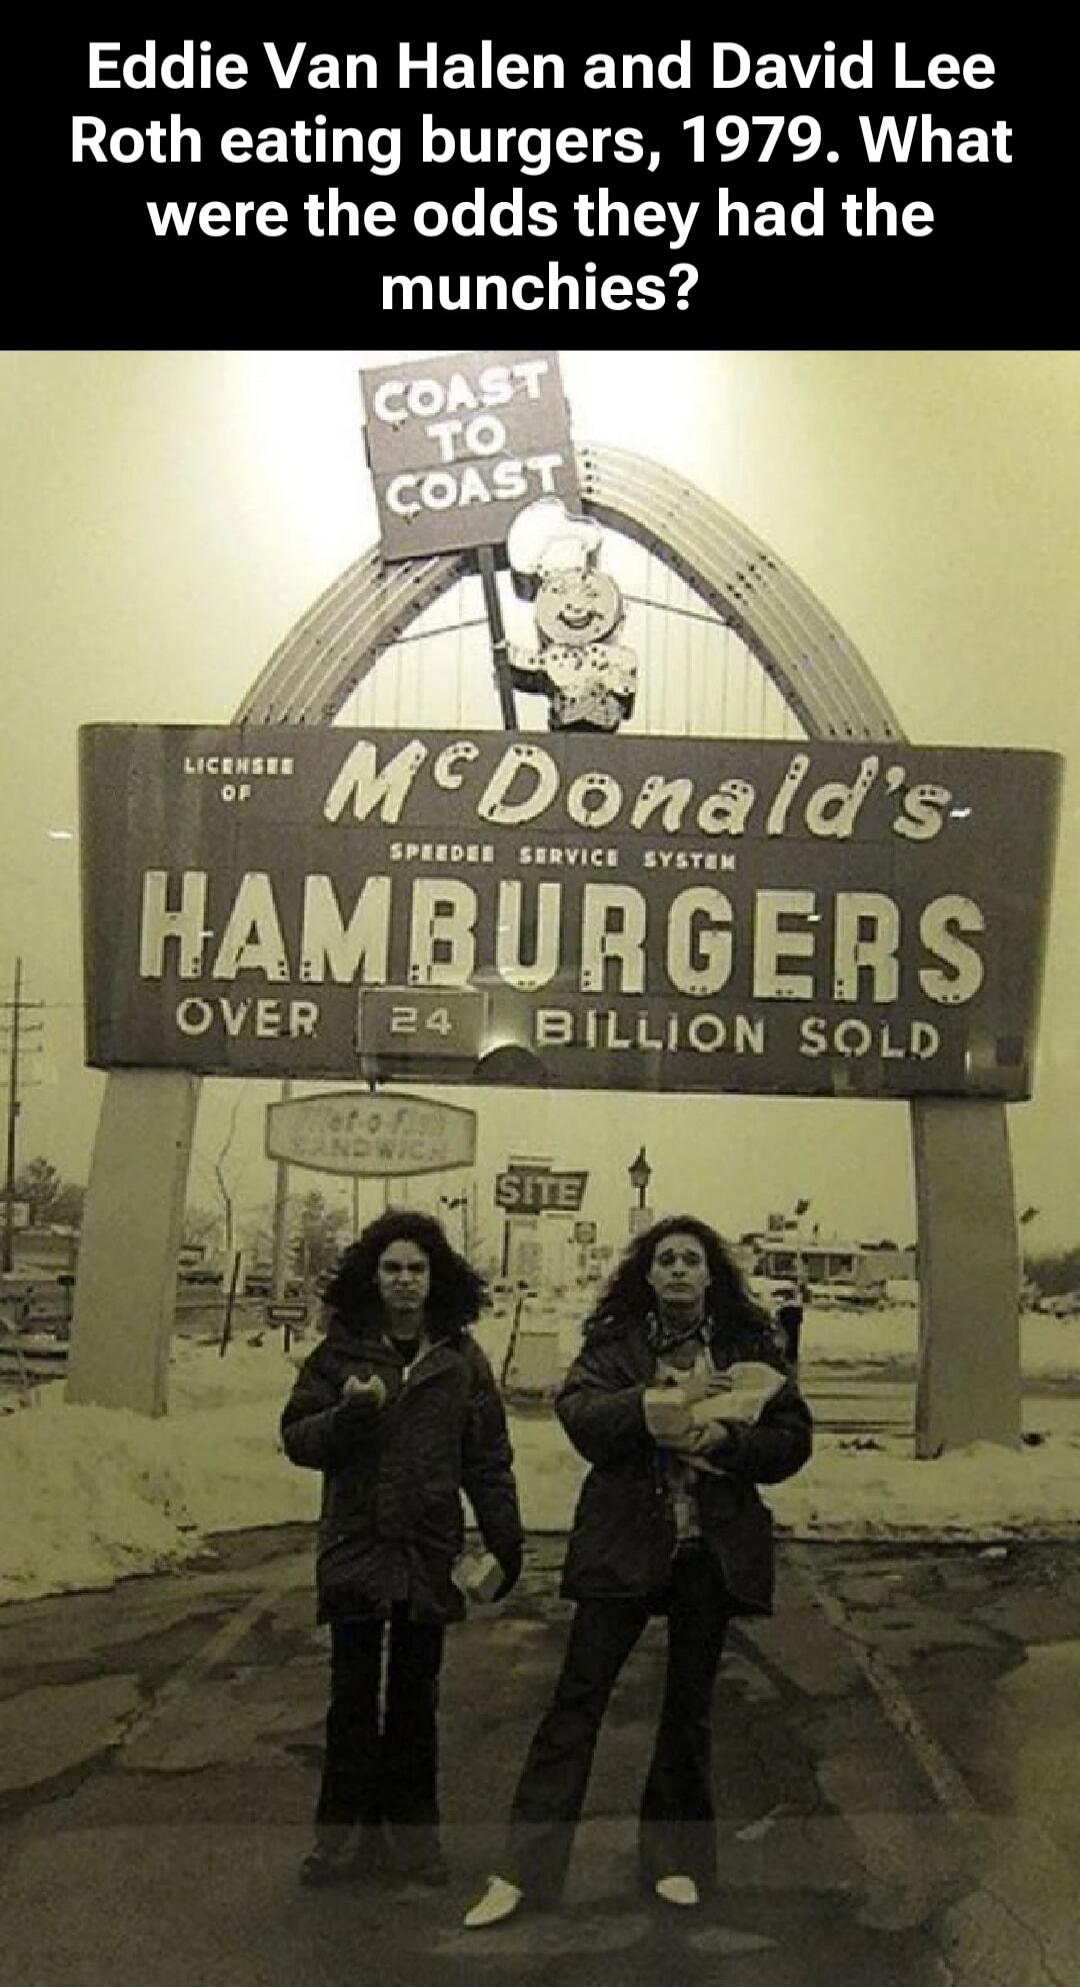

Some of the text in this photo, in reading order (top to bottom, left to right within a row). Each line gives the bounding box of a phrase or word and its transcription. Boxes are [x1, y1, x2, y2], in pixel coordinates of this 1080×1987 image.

[374, 359, 549, 423] COAST
[425, 414, 506, 462] TO
[386, 454, 564, 515] COAST
[183, 756, 295, 775] LICENSEE
[221, 783, 251, 802] OF
[389, 842, 736, 871] SPEEDEE SERVICE SYSTEM
[139, 869, 986, 1004] HAMBURGERS
[175, 997, 940, 1059] OVER 24 BILLION SOLD
[500, 1174, 583, 1204] SITE
